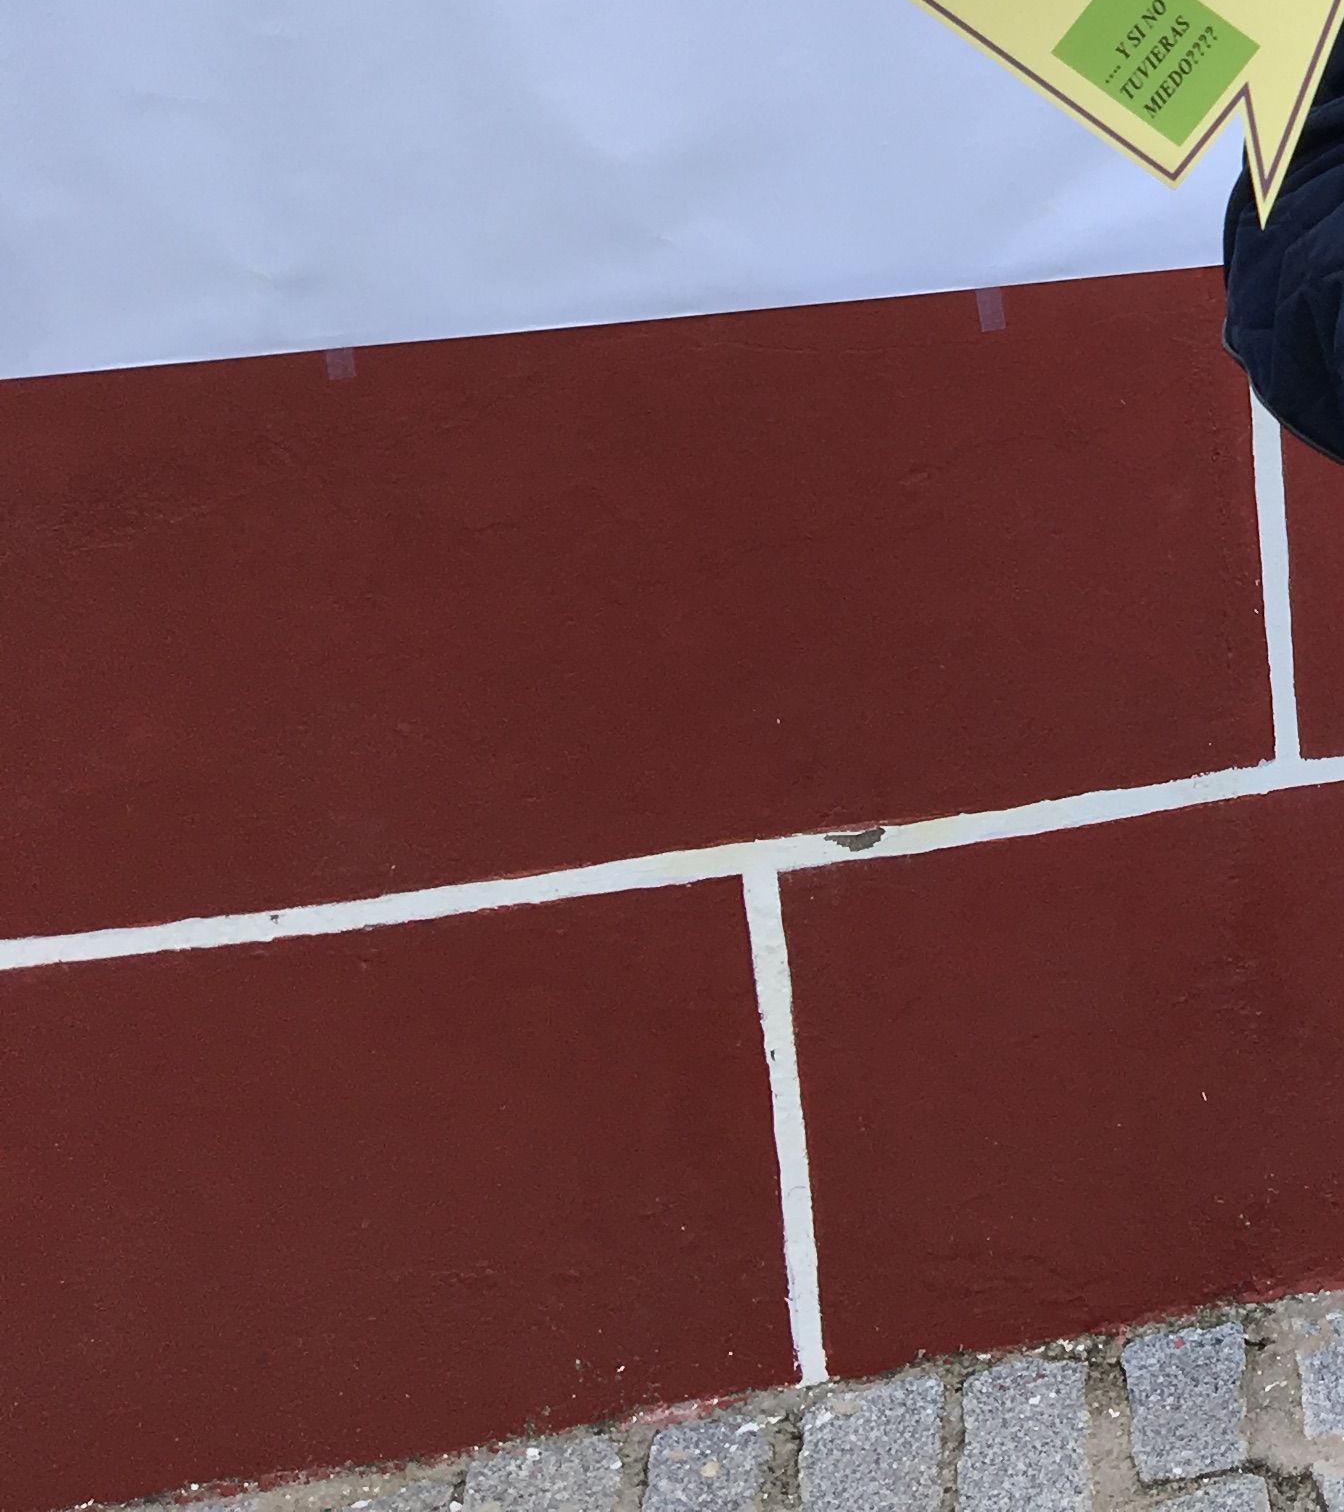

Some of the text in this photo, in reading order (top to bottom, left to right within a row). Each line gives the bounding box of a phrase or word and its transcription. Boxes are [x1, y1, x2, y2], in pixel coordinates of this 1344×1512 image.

[1115, 42, 1131, 60] Y
[1127, 24, 1147, 48] SI
[1120, 15, 1191, 101] TUVIERAS
[1144, 26, 1218, 119] MIEDO????
